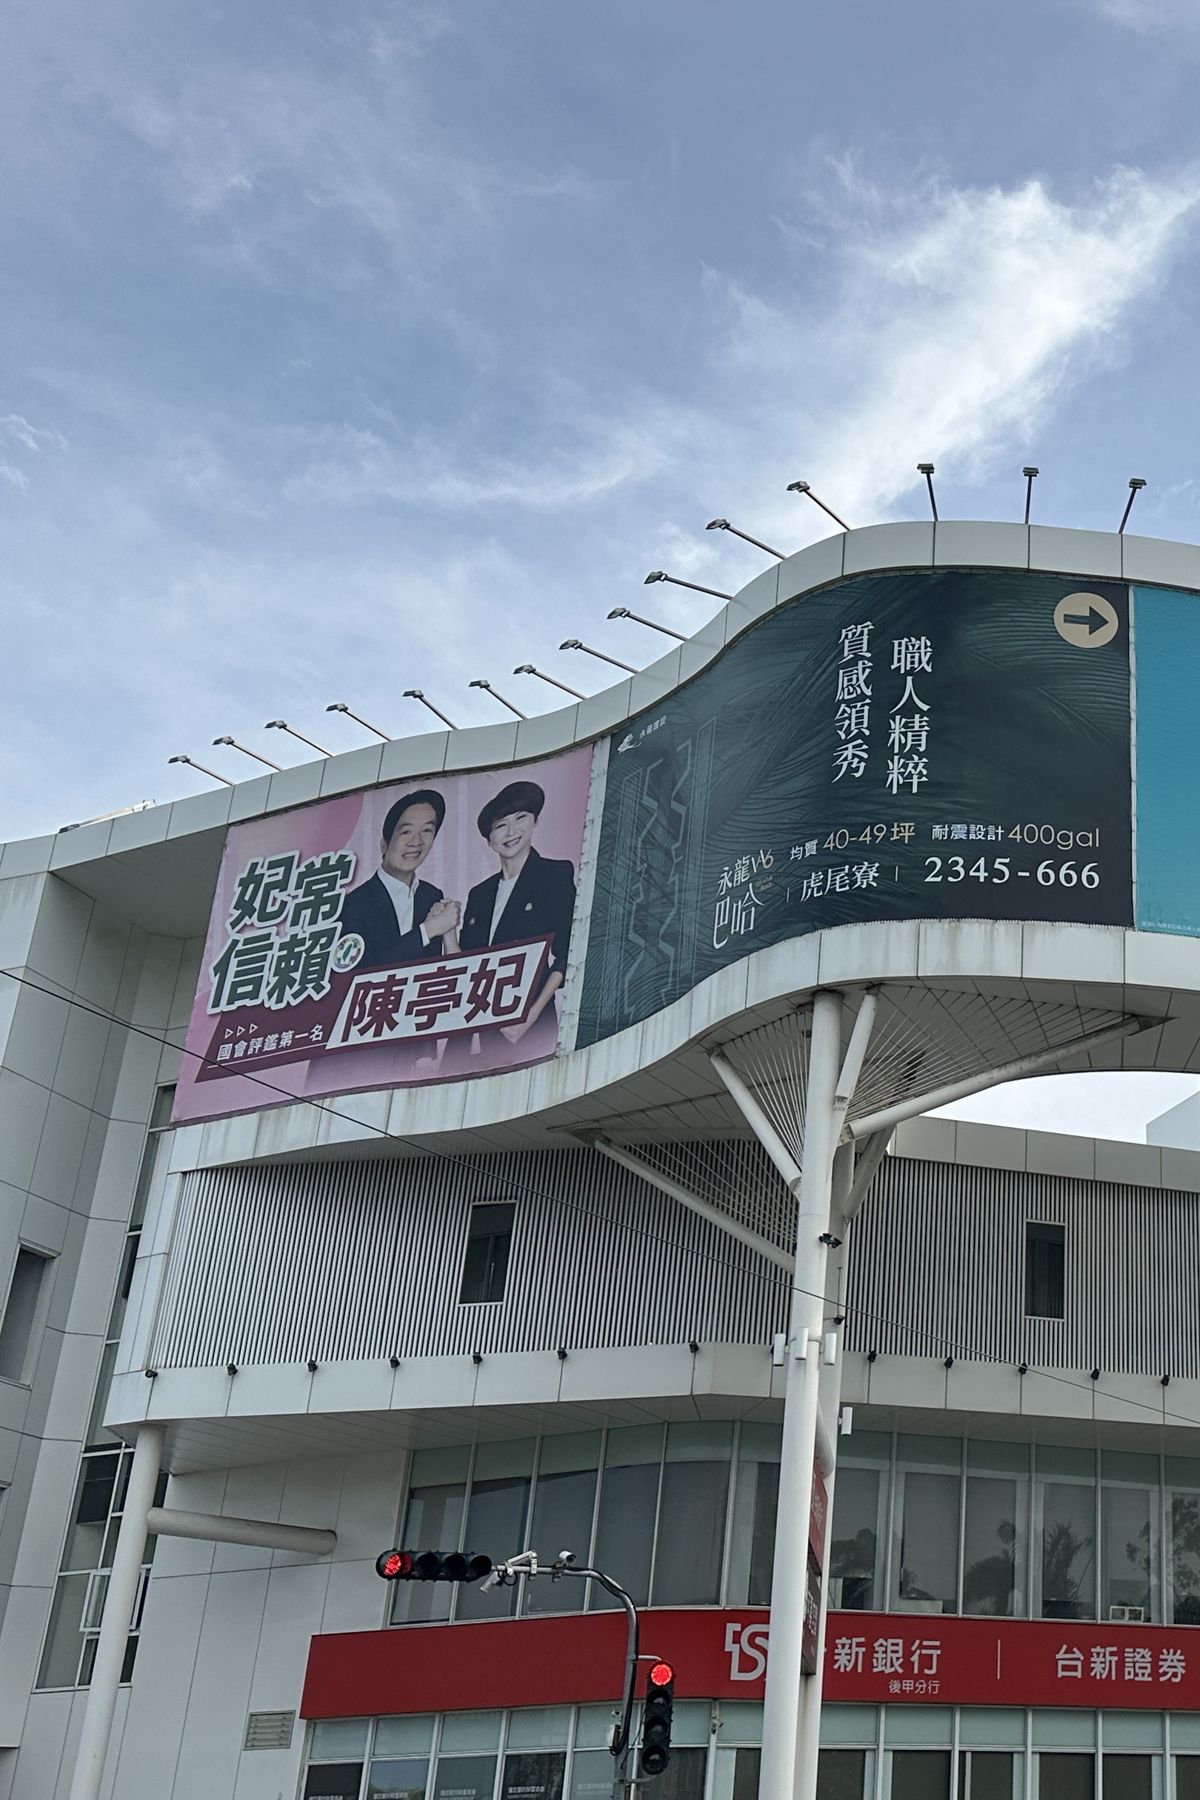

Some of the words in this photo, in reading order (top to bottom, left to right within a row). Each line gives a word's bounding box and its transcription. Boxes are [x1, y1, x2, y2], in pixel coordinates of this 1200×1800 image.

[832, 621, 875, 784] 質感領秀
[885, 636, 933, 795] 職人精粹
[228, 851, 353, 932] 妃常
[800, 861, 880, 902] 虎尾寮
[924, 857, 1100, 889] 2345-666
[713, 883, 765, 949] 巴哈
[209, 923, 337, 1012] 信賴
[341, 953, 526, 1042] 陳亭妃
[217, 1024, 323, 1061] 國會評鑑第一名
[823, 1636, 942, 1675] 新銀行
[888, 1679, 940, 1695] 後甲分行
[1055, 1644, 1187, 1683] 台新證券
